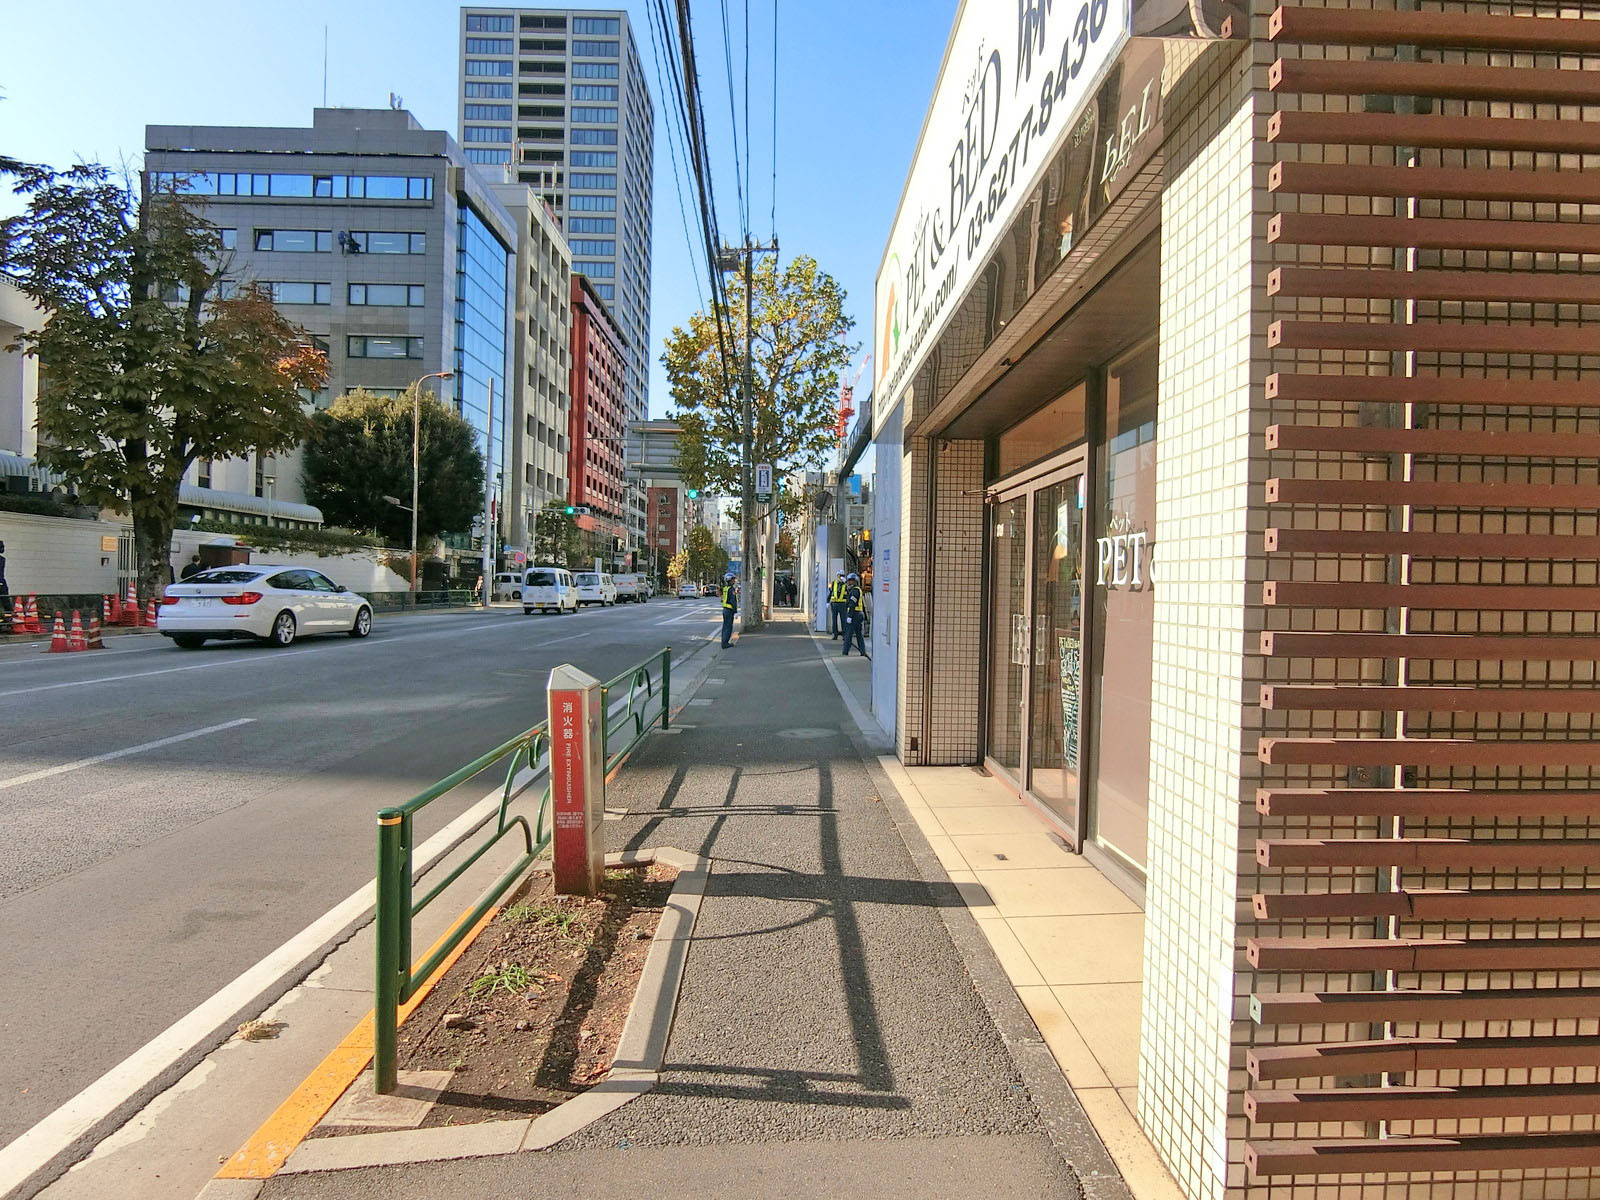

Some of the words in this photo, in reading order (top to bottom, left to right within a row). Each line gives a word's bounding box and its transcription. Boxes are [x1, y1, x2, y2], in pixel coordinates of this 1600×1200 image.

[905, 212, 929, 334] PET
[930, 207, 946, 270] &
[948, 49, 1001, 243] BED
[967, 0, 1108, 260] 03-6277-8436
[1096, 532, 1146, 585] PET
[562, 702, 573, 739] 消火器
